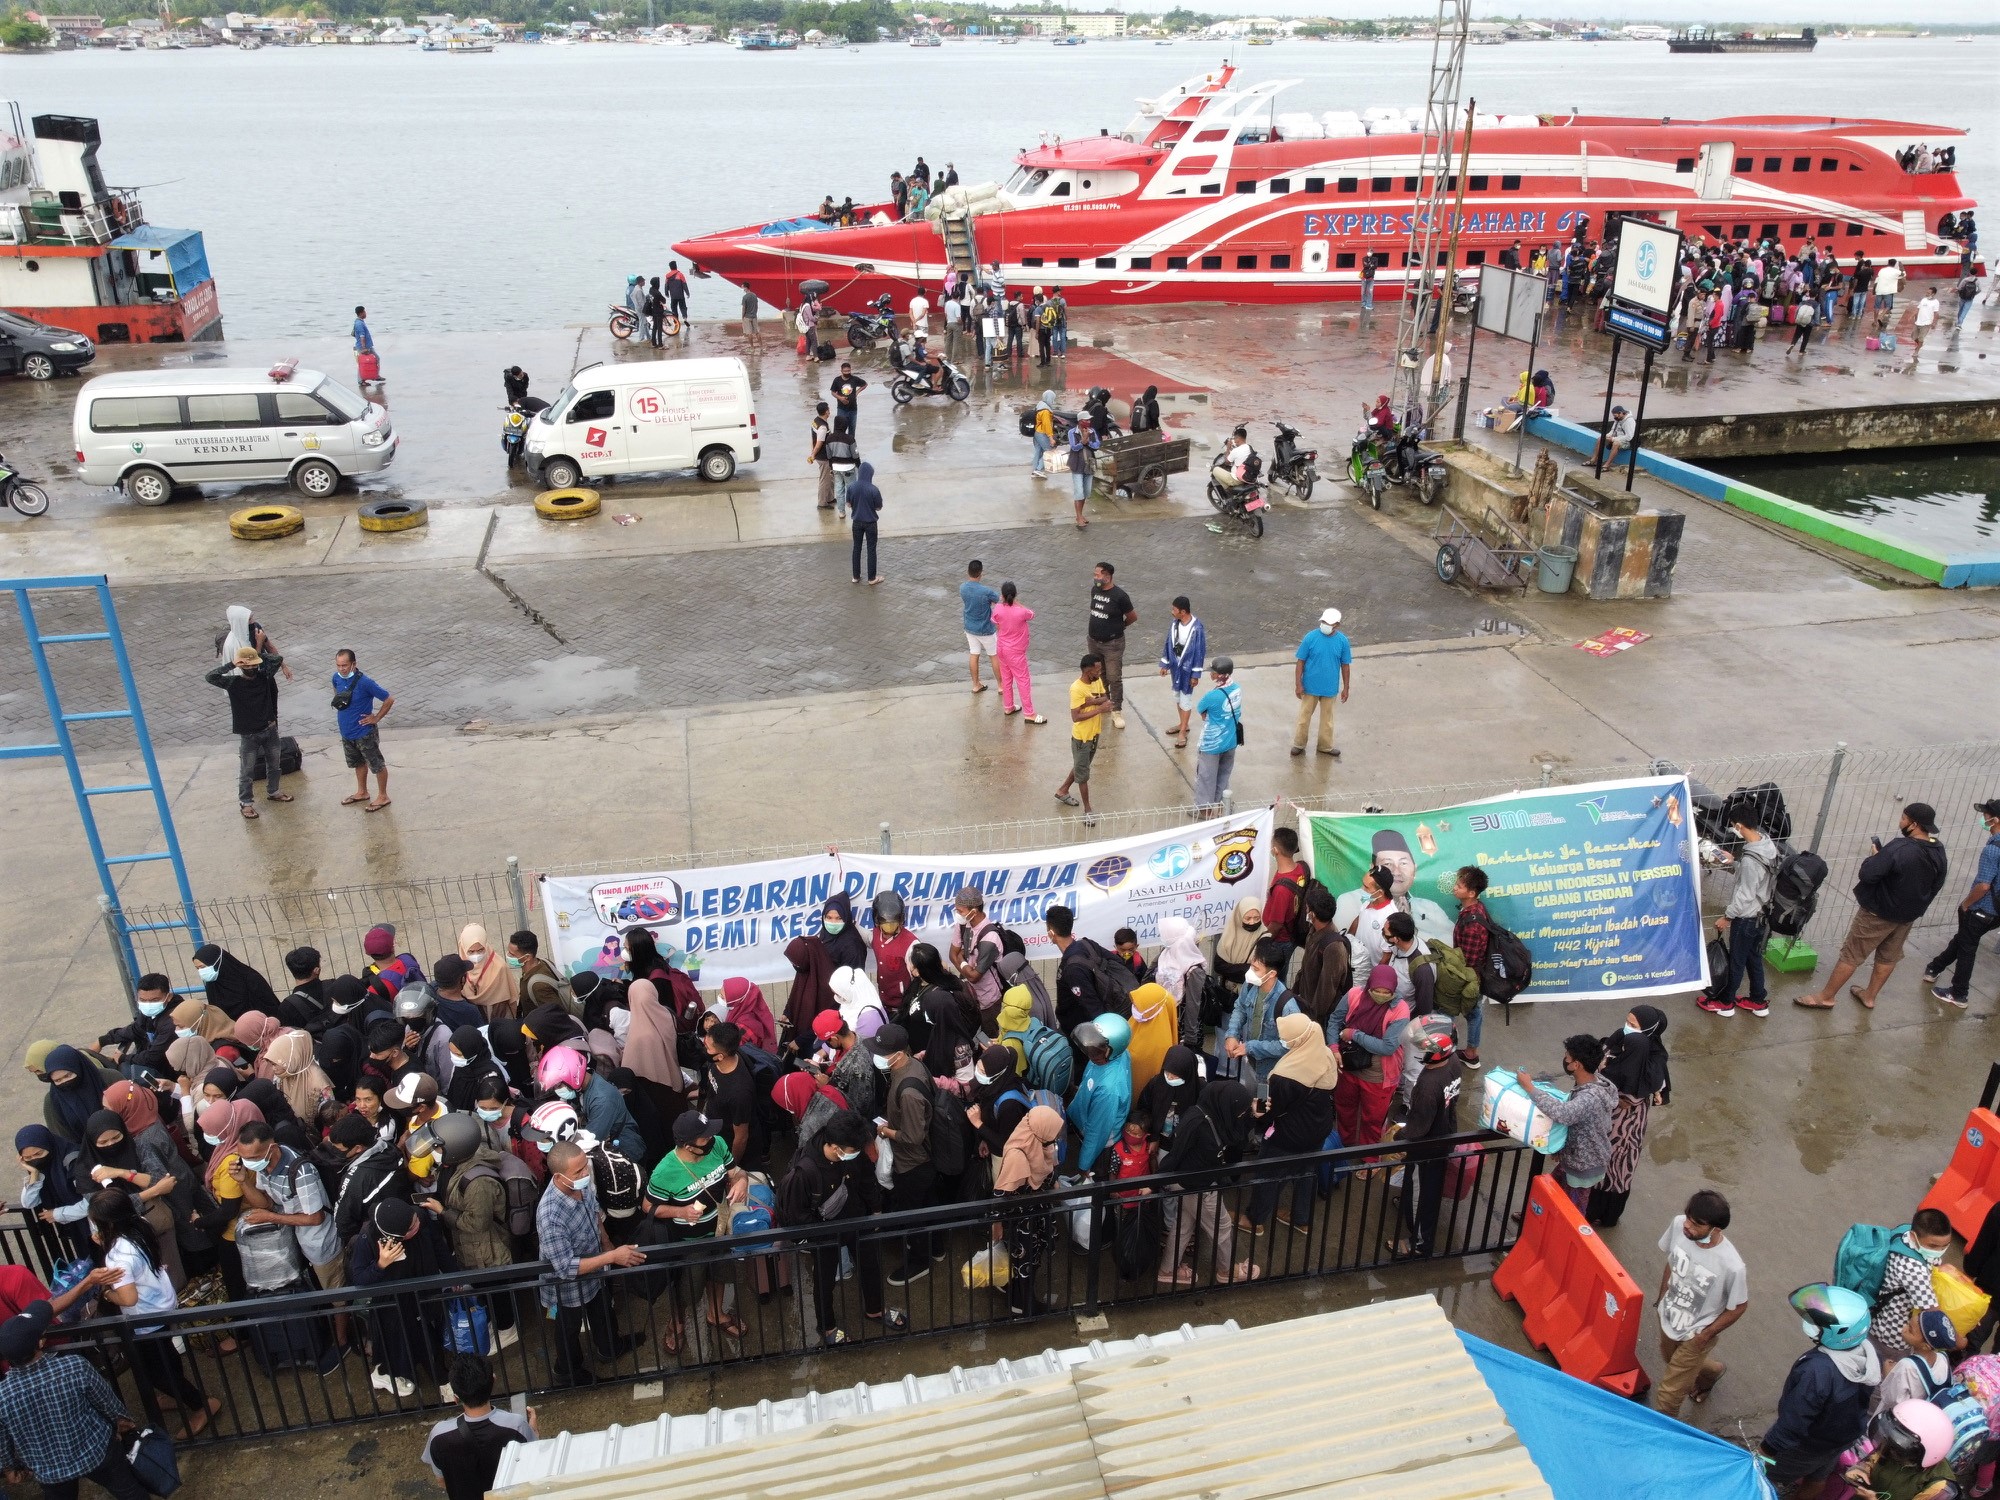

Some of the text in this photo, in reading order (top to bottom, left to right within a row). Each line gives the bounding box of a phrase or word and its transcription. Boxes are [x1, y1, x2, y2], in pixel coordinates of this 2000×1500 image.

[1303, 212, 1438, 236] EXPRESS
[1447, 210, 1547, 235] BAHARI
[636, 397, 659, 414] 15
[654, 413, 702, 424] DELIVERY
[174, 434, 270, 446] KANTOR KESEHATAN PELABUHAN
[193, 444, 253, 454] KENDARI
[1528, 856, 1623, 877] Keluarga Besar
[1128, 878, 1212, 899] JASA RAHARJA
[1485, 864, 1683, 899] PELABUHAN INDONESIA IV (PERSERO)
[597, 886, 623, 896] TUNDA
[683, 862, 1080, 921] LEBARAN DI RUMAH AJA
[1533, 885, 1634, 908] CABANG KENDARI
[1143, 899, 1168, 907] member
[684, 917, 761, 954] DEMI
[938, 889, 1079, 927] KUARGA
[1126, 912, 1159, 929] PAM
[1552, 906, 1616, 923] mengucapkan
[1538, 921, 1602, 939] Menunaikan
[1605, 915, 1639, 932] Ibadah
[1640, 914, 1669, 928] Puasa
[1553, 935, 1621, 955] 1442 Hijriah
[1558, 957, 1582, 970] Maaf
[1617, 972, 1643, 982] Pelindo
[1651, 969, 1676, 979] Kendari
